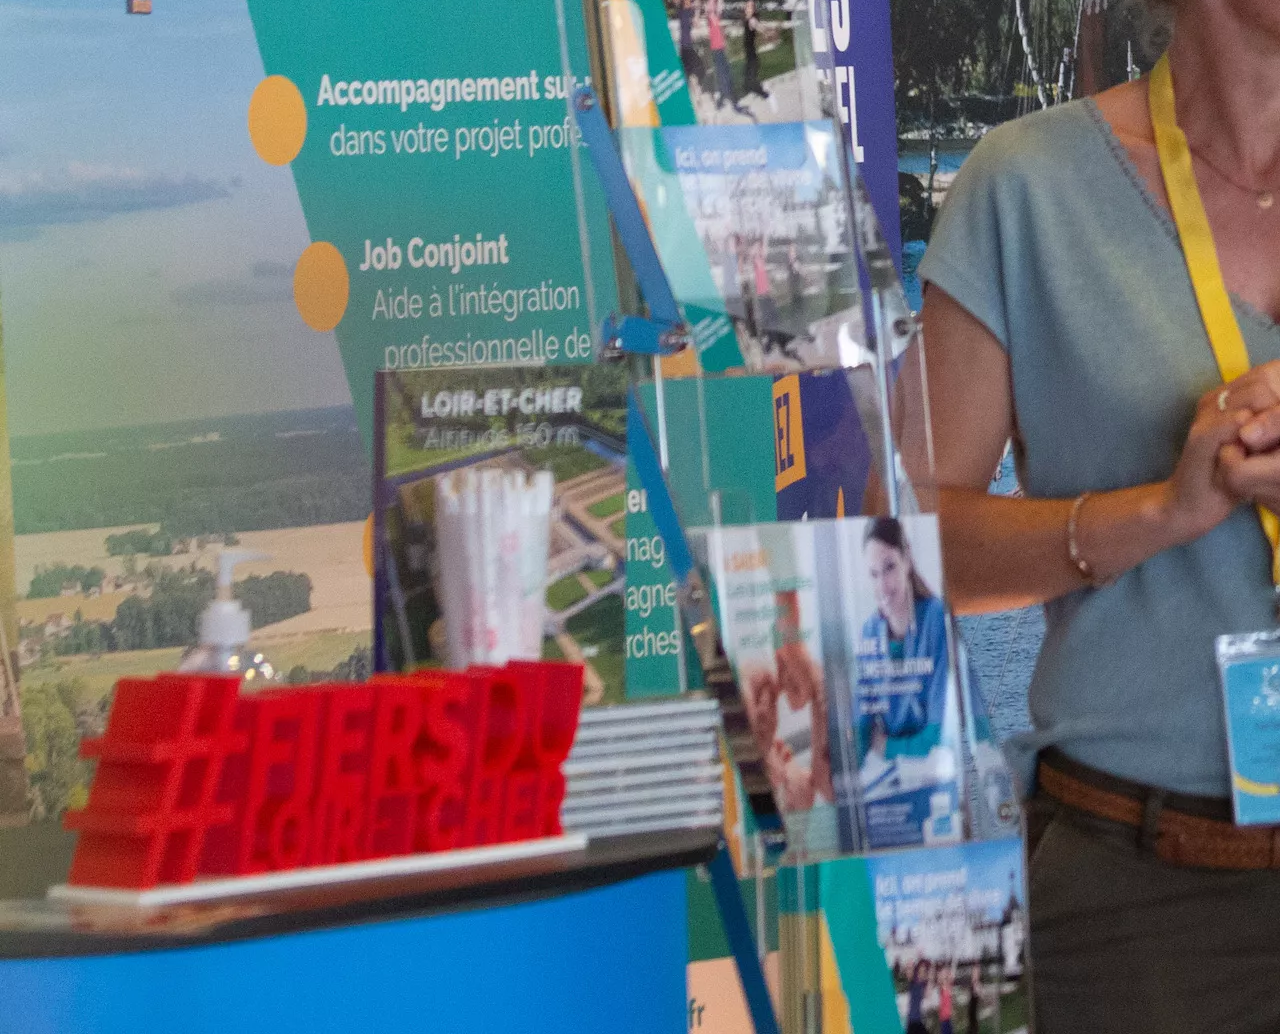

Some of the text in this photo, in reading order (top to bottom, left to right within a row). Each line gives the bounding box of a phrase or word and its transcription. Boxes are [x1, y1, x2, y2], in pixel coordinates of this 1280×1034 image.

[316, 69, 541, 113] Accompagnement
[329, 122, 387, 157] dans
[393, 120, 449, 154] votre
[455, 117, 524, 161] projet
[359, 232, 510, 275] Job Conjoint
[371, 278, 580, 323] Aide à l'intégration
[384, 326, 592, 372] professionnelle de
[420, 386, 583, 419] LOIR-ET-CHER
